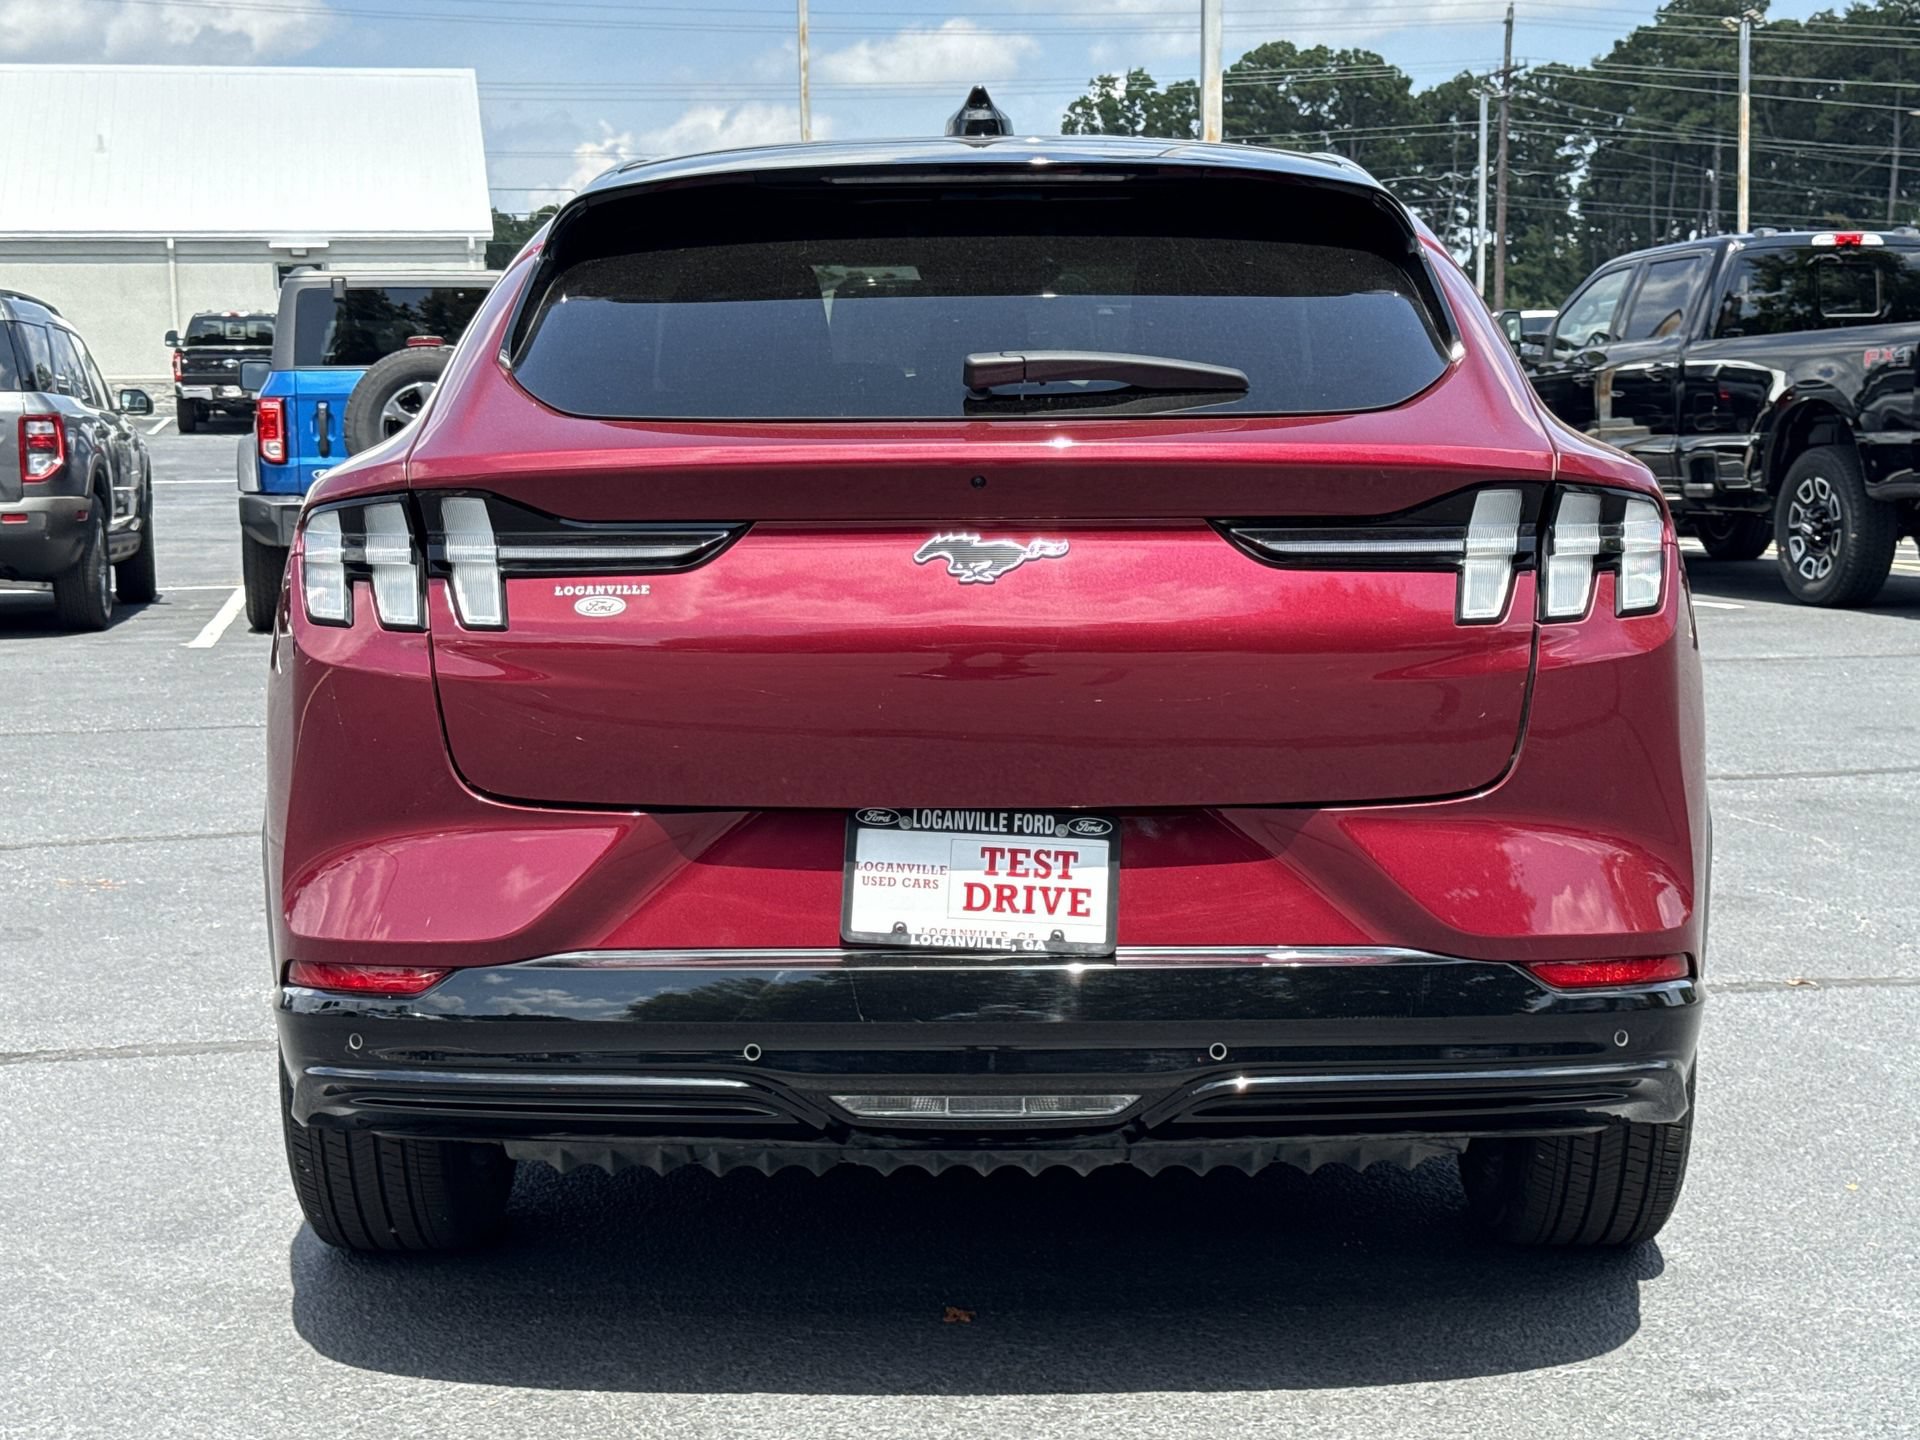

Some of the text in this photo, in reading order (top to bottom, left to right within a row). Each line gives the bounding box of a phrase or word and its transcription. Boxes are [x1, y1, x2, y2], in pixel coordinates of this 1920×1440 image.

[1863, 345, 1911, 369] FX4
[554, 584, 650, 596] LOGANVILLE
[913, 808, 1055, 835] LOGANVILLE FORD
[855, 861, 948, 876] LOGANVILLE
[980, 846, 1079, 880] TEST
[862, 875, 939, 890] USED CARS
[962, 882, 1092, 917] DRIVE
[910, 933, 1047, 952] LOGANVILLE, GA
